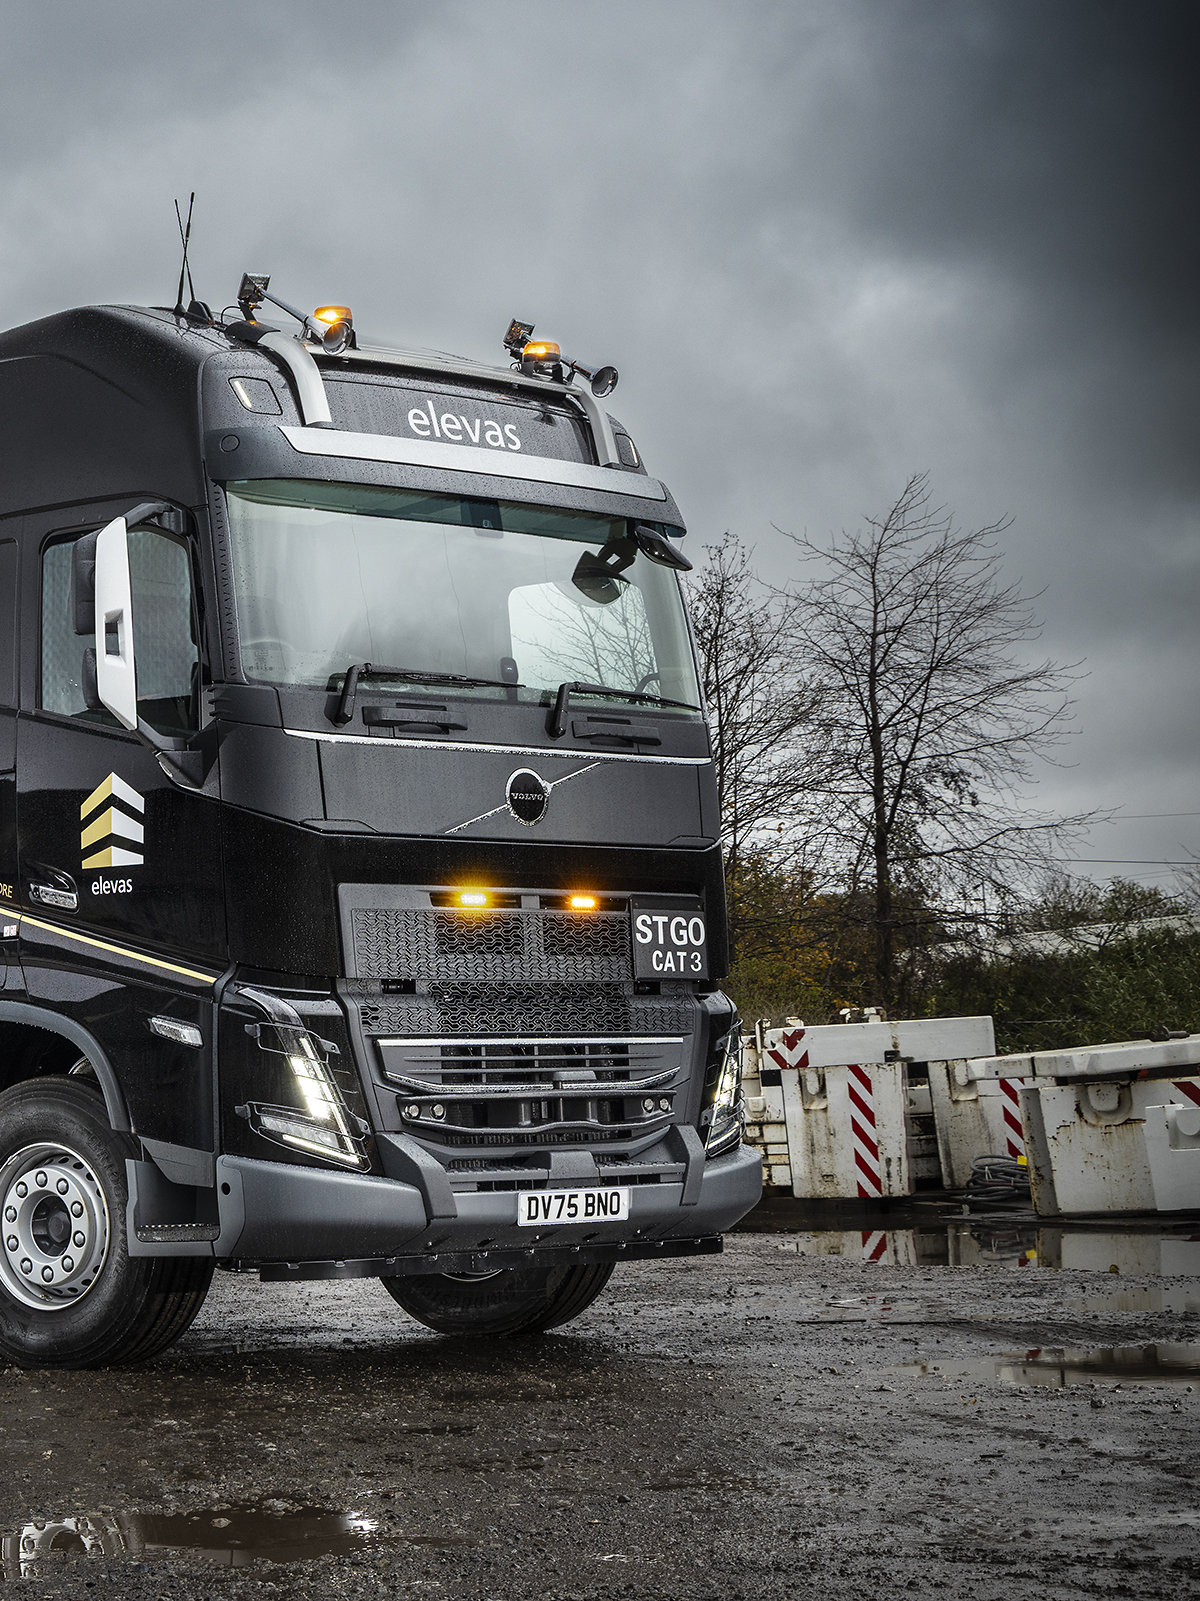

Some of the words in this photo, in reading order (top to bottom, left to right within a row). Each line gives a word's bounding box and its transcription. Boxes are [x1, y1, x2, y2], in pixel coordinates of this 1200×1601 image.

[407, 399, 522, 450] elevas
[510, 792, 544, 800] VOLVO
[91, 875, 133, 895] elevas
[635, 914, 706, 946] STGO
[652, 949, 688, 972] CAT
[690, 951, 703, 972] 3
[526, 1193, 579, 1221] DV75
[584, 1191, 621, 1218] BNO
